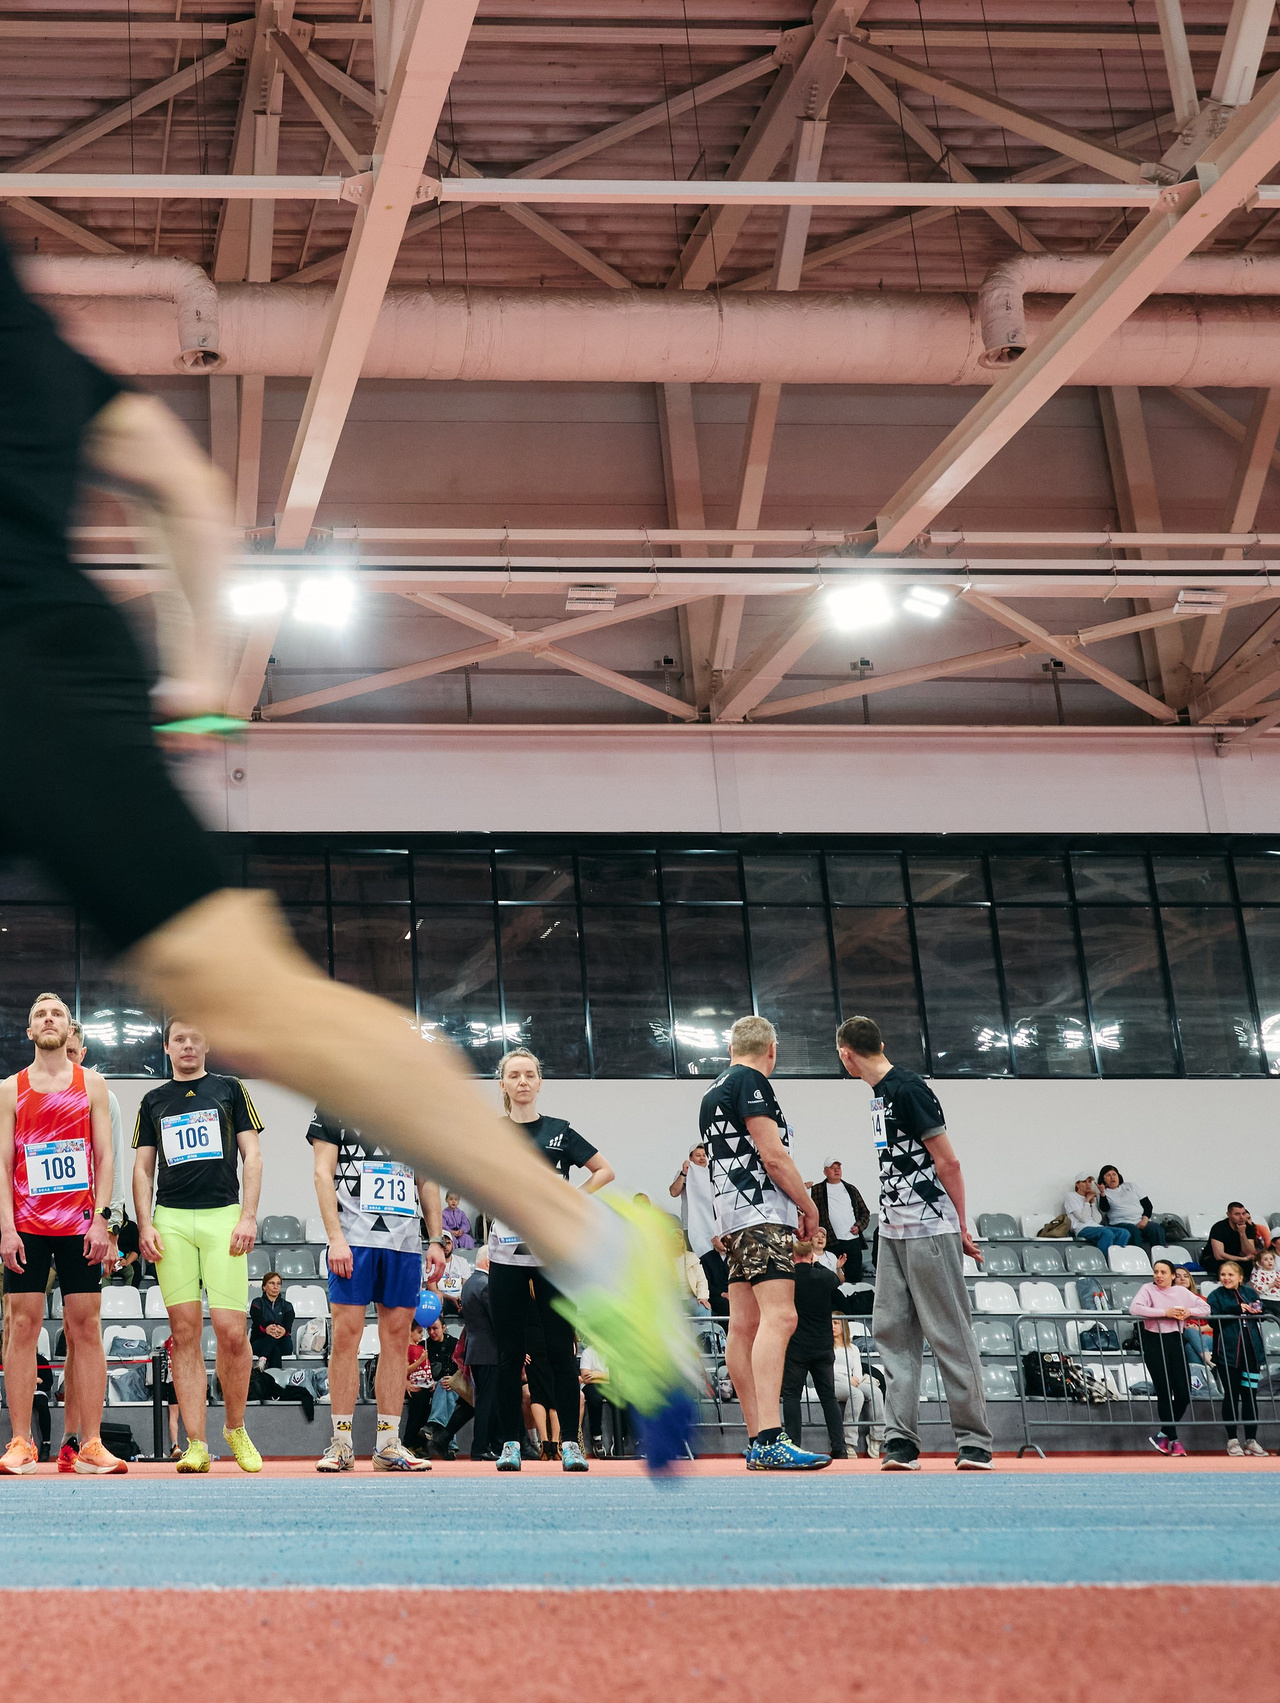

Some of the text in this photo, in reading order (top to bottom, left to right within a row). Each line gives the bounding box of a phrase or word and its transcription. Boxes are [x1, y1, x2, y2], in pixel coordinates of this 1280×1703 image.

[176, 1126, 209, 1150] 106
[41, 1156, 76, 1180] 108
[374, 1177, 405, 1202] 213
